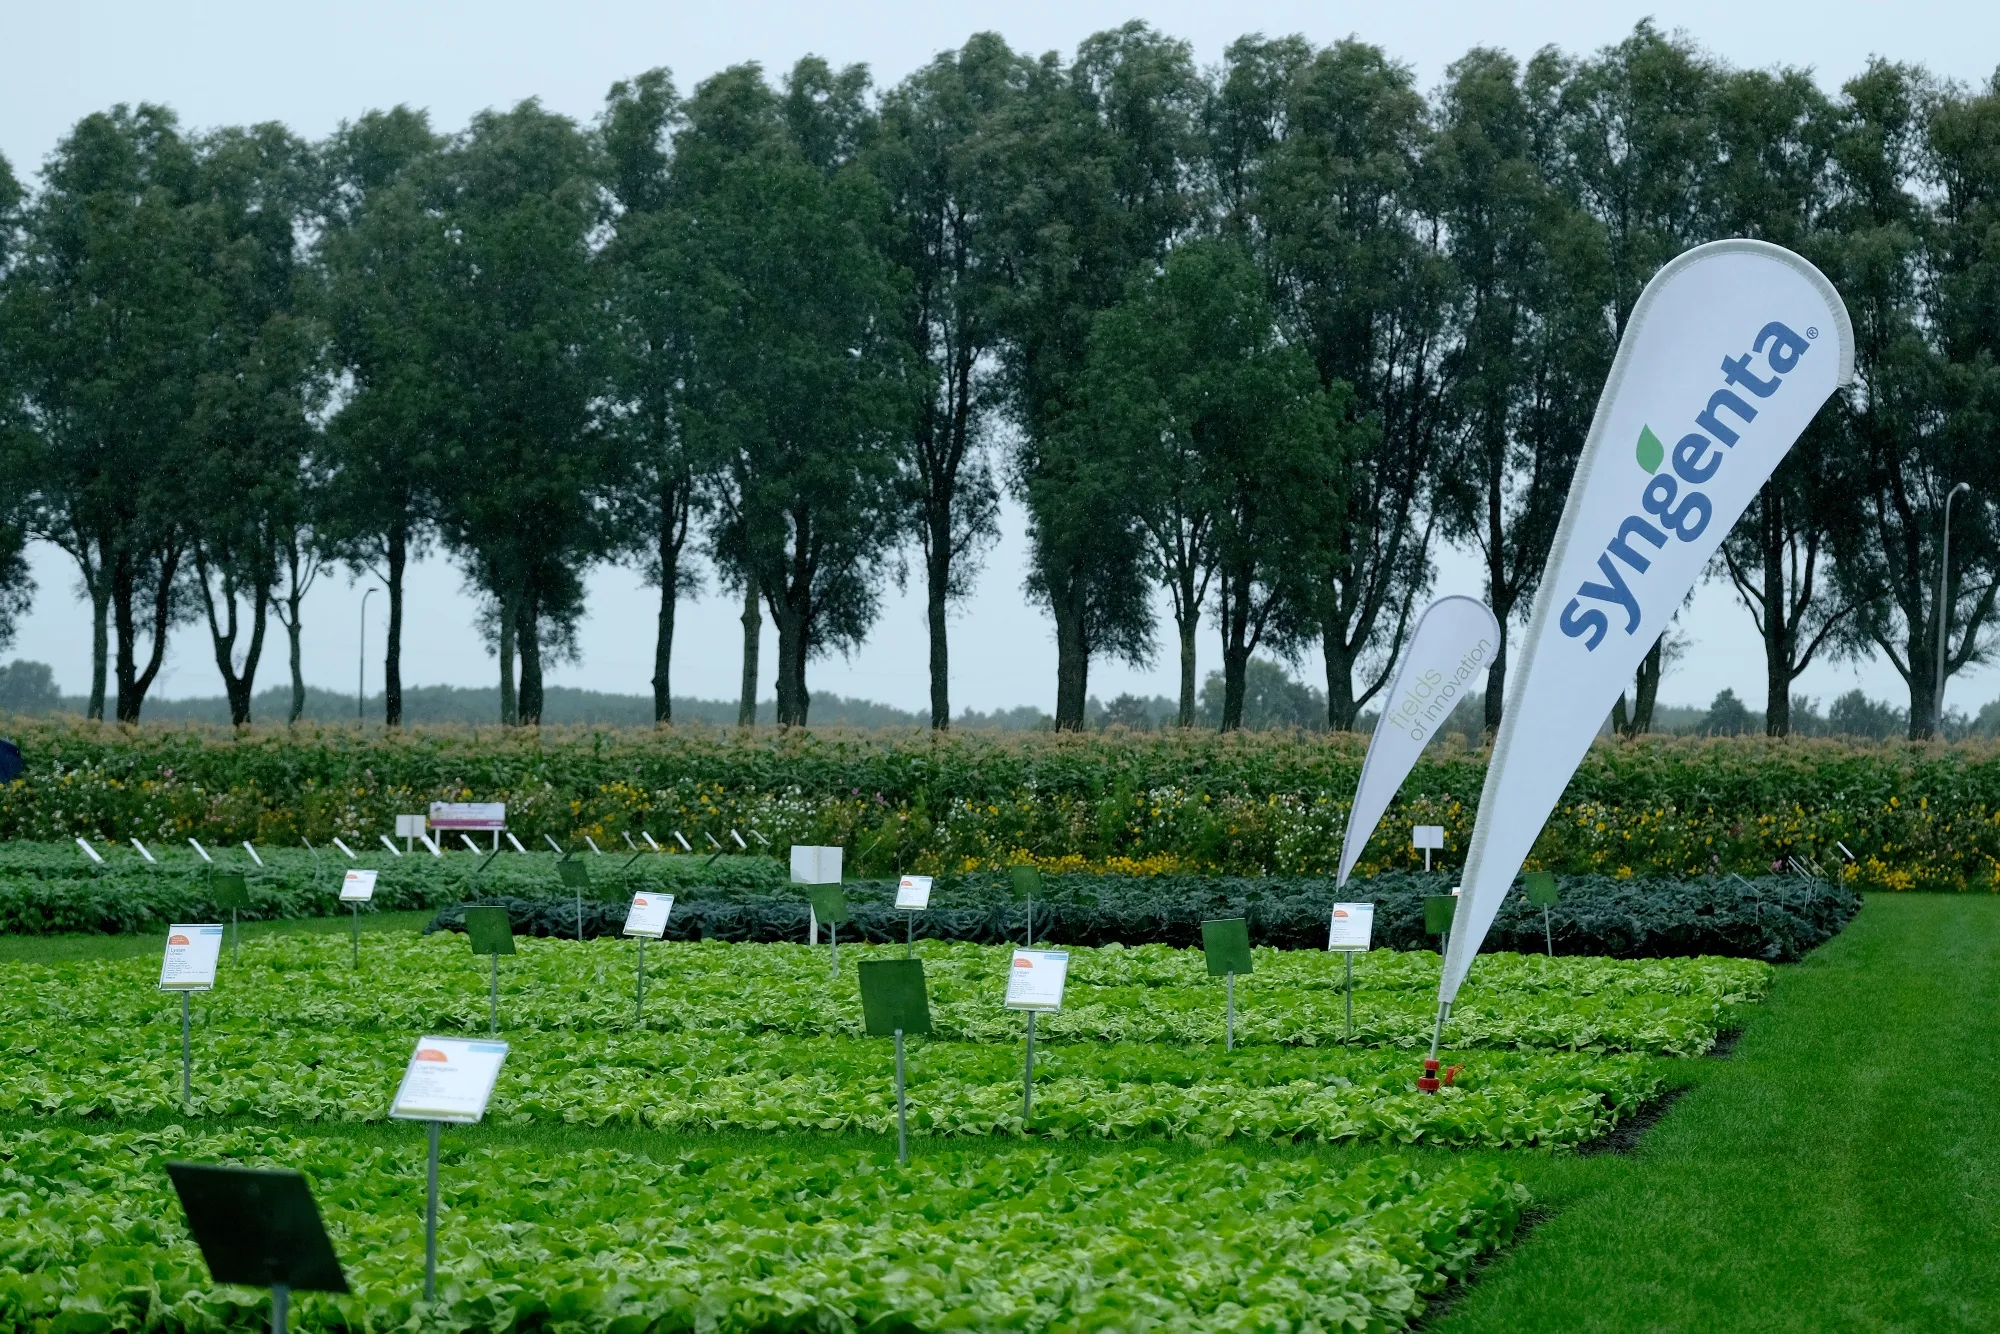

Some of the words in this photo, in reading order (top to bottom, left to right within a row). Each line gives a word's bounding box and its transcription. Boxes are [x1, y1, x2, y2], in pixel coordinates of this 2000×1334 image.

[1388, 668, 1442, 730] fields
[1411, 719, 1428, 741] of
[1421, 638, 1492, 722] innovation
